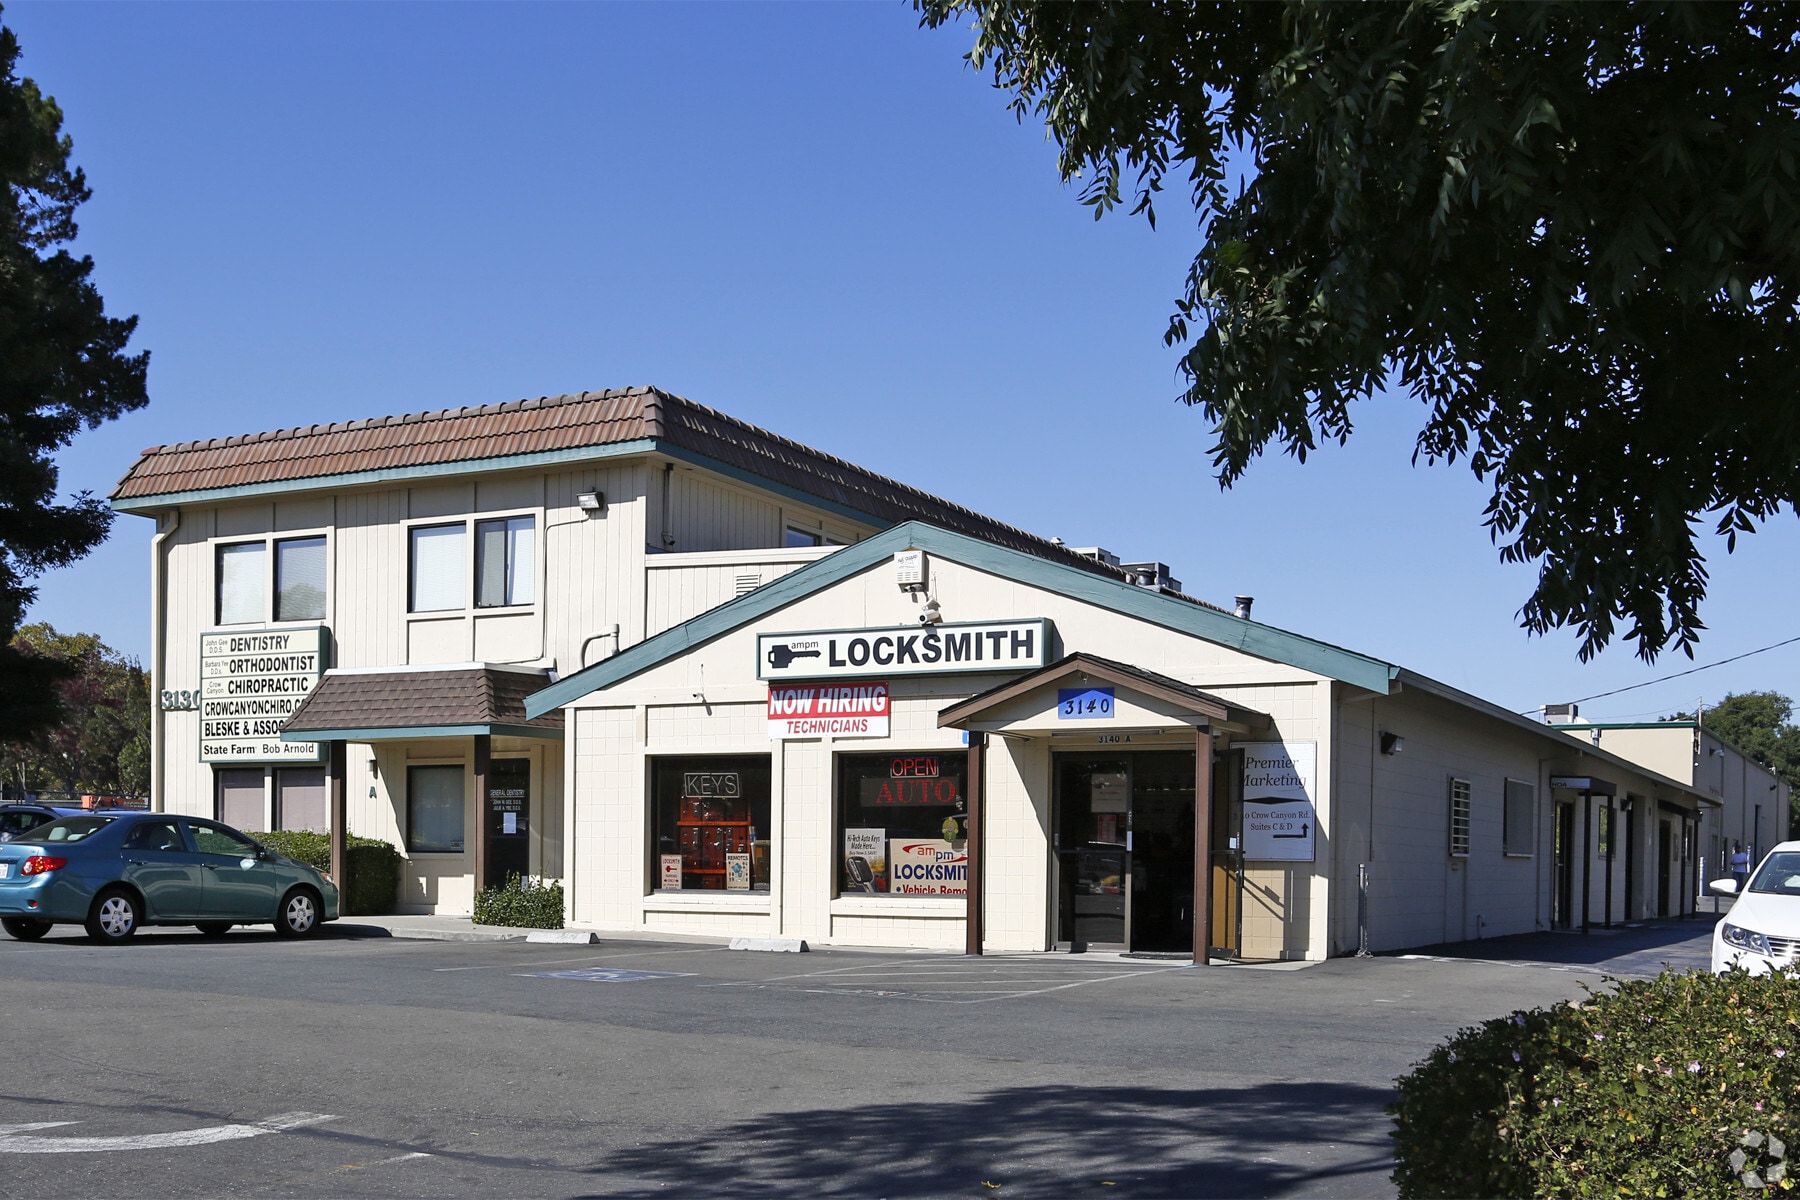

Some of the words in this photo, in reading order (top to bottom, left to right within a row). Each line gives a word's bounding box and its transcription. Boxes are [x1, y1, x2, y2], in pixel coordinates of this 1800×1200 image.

[205, 639, 218, 647] John
[218, 638, 228, 646] Gee
[230, 634, 290, 652] DENTISTRY
[791, 641, 819, 650] ampm
[829, 629, 1034, 667] LOCKSMITH
[205, 660, 221, 668] Barbara
[229, 655, 315, 674] ORTHODONTIST
[206, 687, 225, 696] Canyon
[227, 677, 308, 695] CHIROPRACTIC
[205, 698, 305, 717] CROWCANYONCHIRO.C
[769, 688, 815, 715] NOW
[817, 686, 886, 713] HIRING
[1065, 698, 1110, 715] 3140
[205, 721, 240, 737] BLESKE
[243, 721, 250, 735] &
[787, 719, 868, 734] TECHNICIANS
[204, 744, 228, 755] State
[231, 744, 256, 754] Farm
[262, 743, 280, 754] Bob
[284, 743, 314, 753] Arnold
[892, 758, 938, 776] OPEN
[1245, 755, 1299, 769] Premier
[687, 775, 737, 794] KEYS
[876, 779, 956, 804] AUTO
[369, 786, 377, 799] A
[1251, 811, 1269, 819] Crow
[1270, 811, 1297, 820] Canyon
[1250, 822, 1271, 831] Suites
[1272, 822, 1279, 830] C
[1287, 822, 1293, 830] D
[861, 834, 871, 842] Auto
[871, 834, 880, 843] Keys
[903, 884, 936, 894] Vehicle
